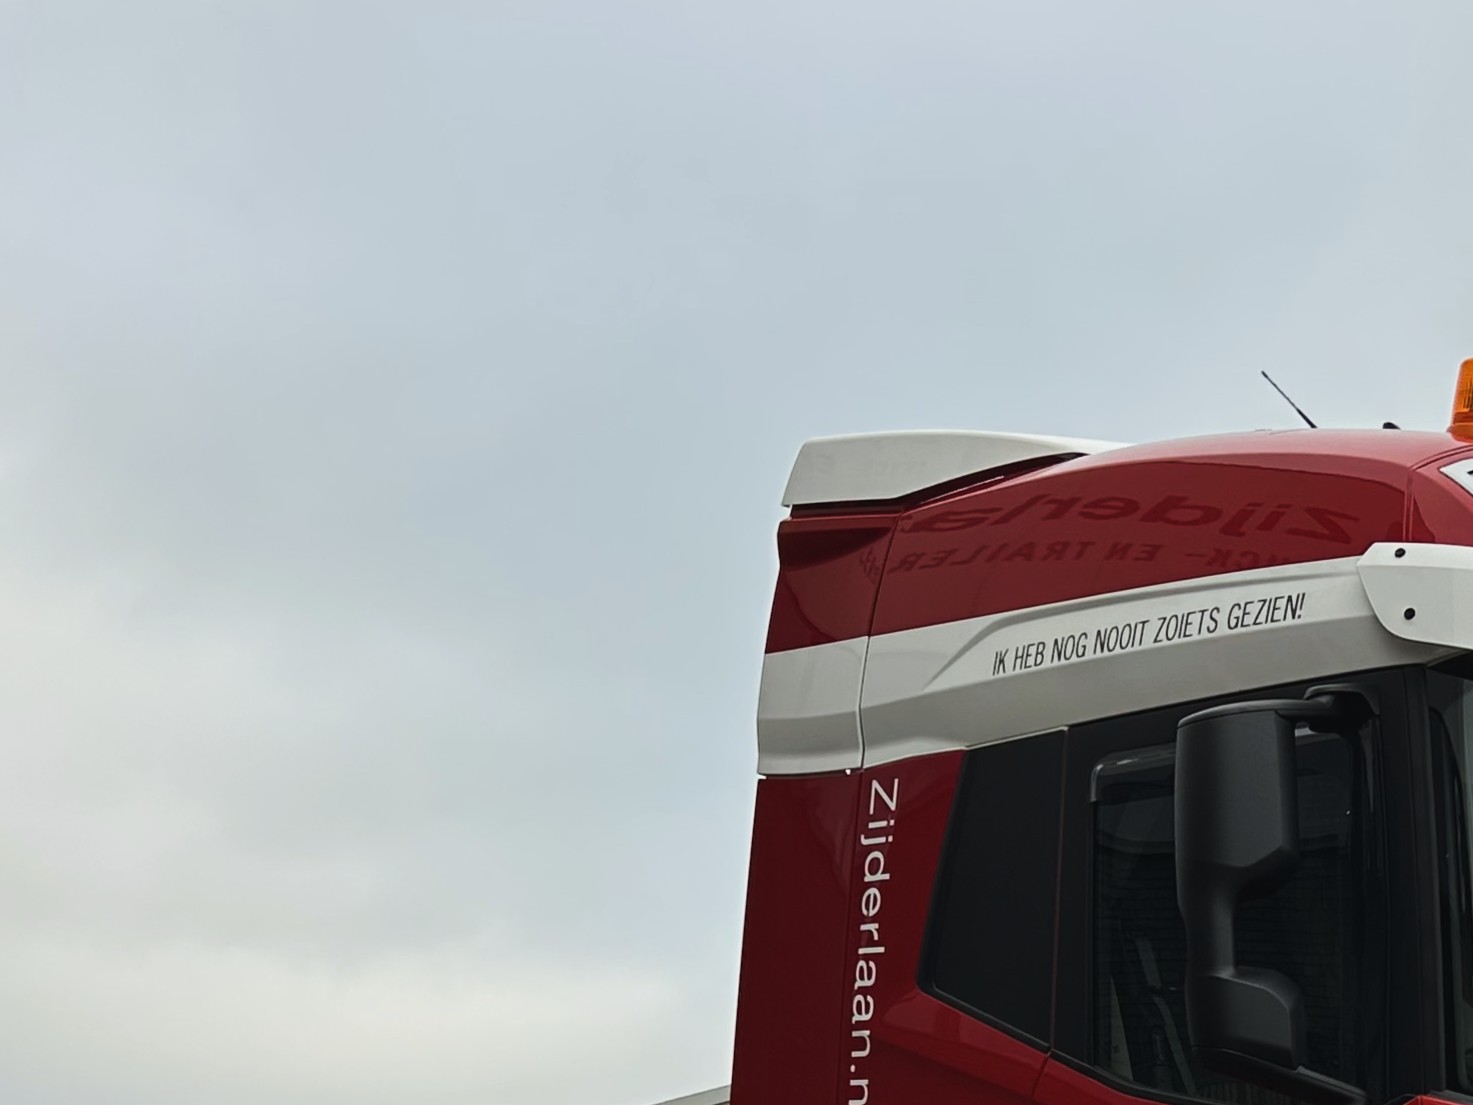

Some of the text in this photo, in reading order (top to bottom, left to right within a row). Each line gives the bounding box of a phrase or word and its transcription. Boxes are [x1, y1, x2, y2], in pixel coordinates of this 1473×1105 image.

[992, 592, 1306, 676] IK HEB NOG NOOIT ZOIETS GEZIEN!
